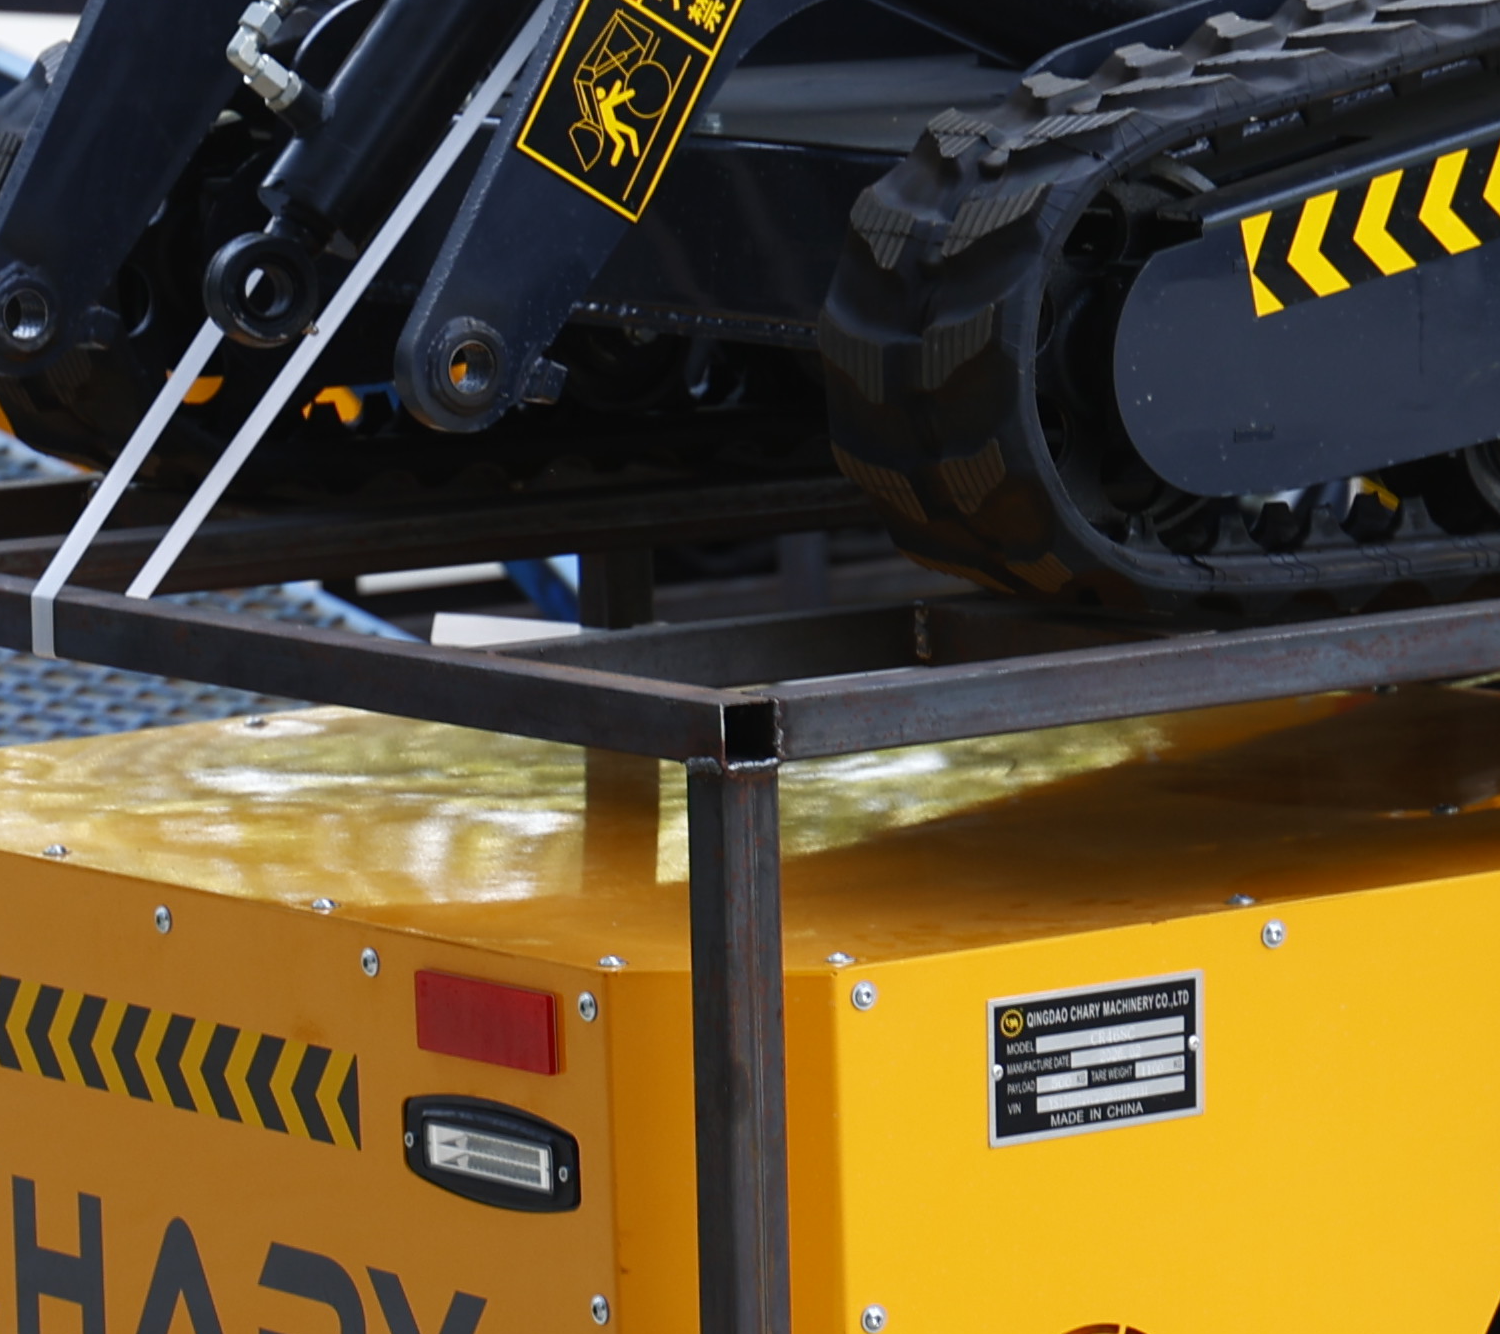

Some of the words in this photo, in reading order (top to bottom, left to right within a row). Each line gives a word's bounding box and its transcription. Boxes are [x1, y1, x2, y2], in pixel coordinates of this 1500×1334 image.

[1026, 1007, 1068, 1028] QINGDAO
[1070, 1002, 1100, 1021] CHARY
[1102, 994, 1154, 1017] MACHINERY
[1006, 1040, 1035, 1056] MODEL
[1006, 1055, 1053, 1076] MANUFACTURE
[1053, 1053, 1070, 1070] DATE
[1091, 1067, 1107, 1083] TARE
[1108, 1064, 1133, 1080] WEIGHT
[1007, 1079, 1036, 1096] PAYLOAD
[1008, 1102, 1021, 1116] VIN
[1050, 1109, 1084, 1127] MADE
[1089, 1106, 1101, 1121] IN
[1107, 1100, 1144, 1119] CHINA
